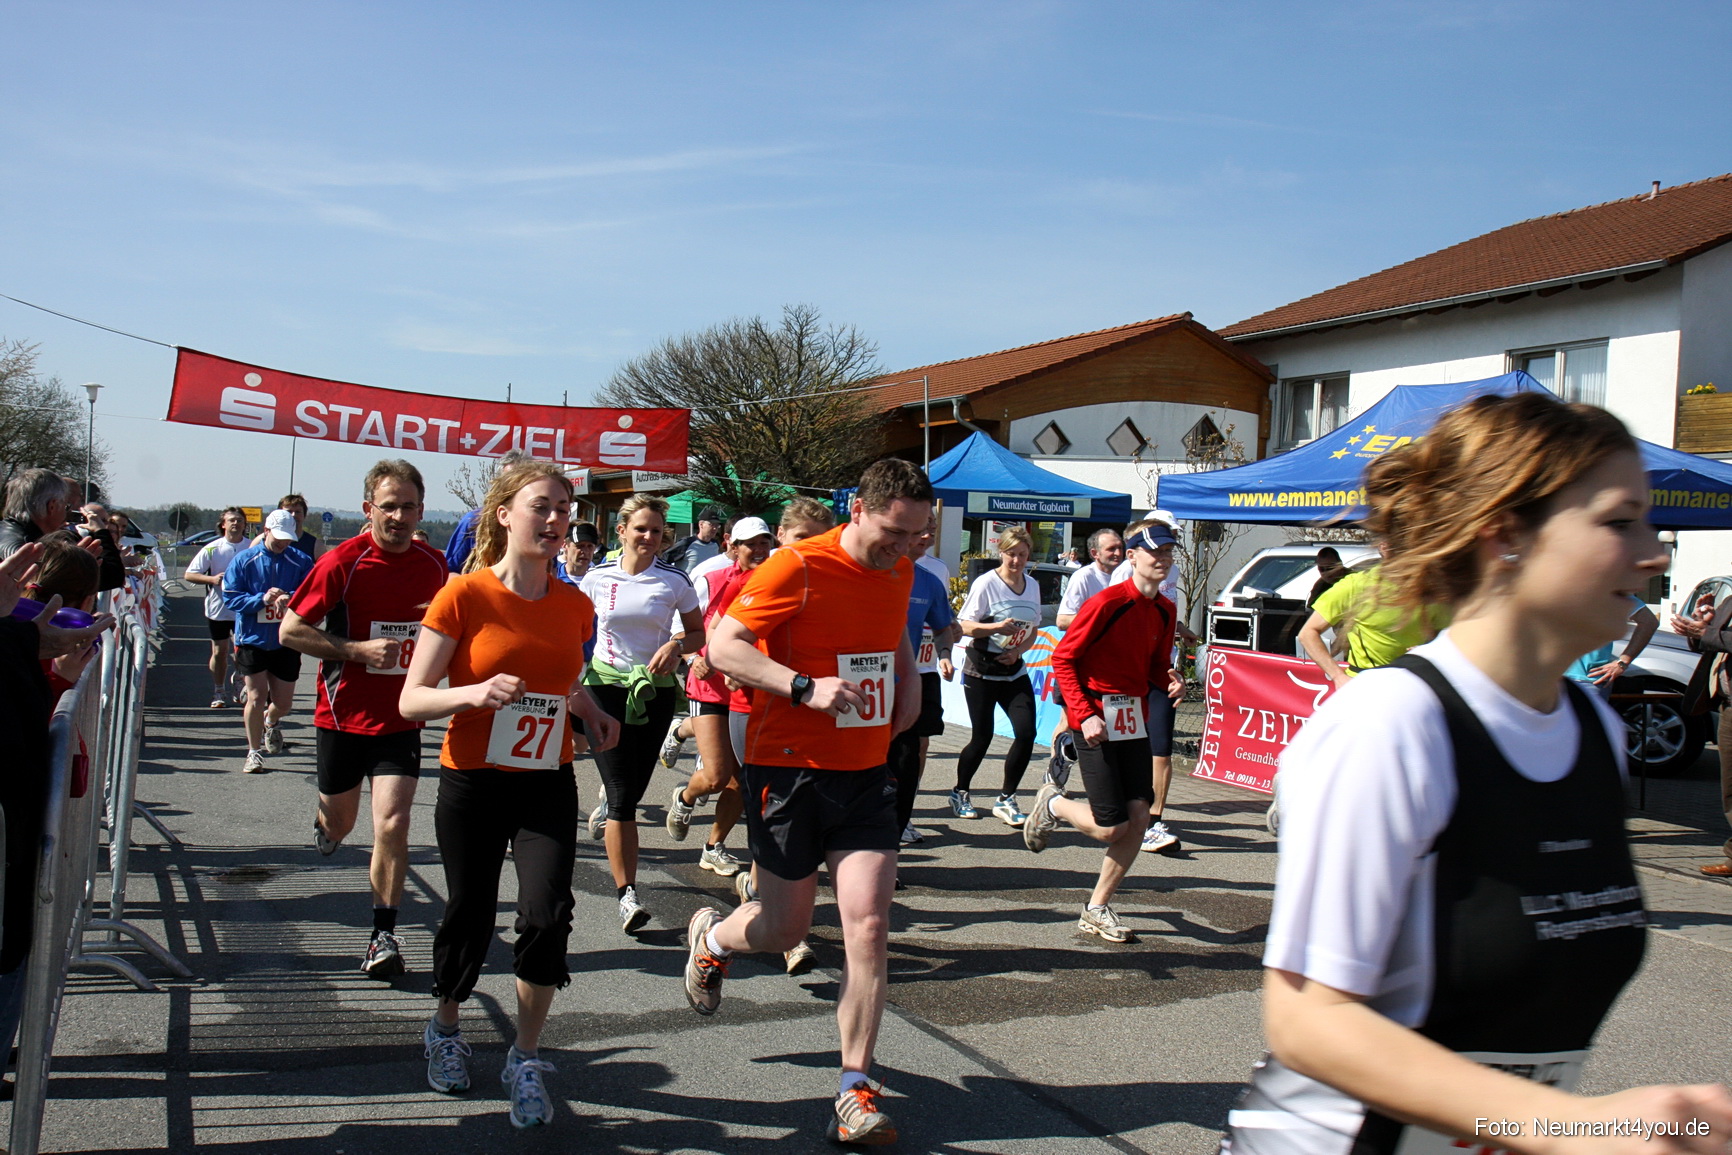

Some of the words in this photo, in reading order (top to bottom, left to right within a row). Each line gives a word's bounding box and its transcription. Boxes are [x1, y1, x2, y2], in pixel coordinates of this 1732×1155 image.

[992, 499, 1037, 511] Neumarkter
[1038, 501, 1070, 513] Tagblatt
[1648, 489, 1732, 509] mmane
[399, 639, 415, 669] 8
[850, 656, 879, 666] MEYER
[919, 643, 933, 663] 18
[850, 665, 879, 673] WERBUNG
[511, 704, 546, 714] WERBUNG
[1199, 652, 1227, 777] ZEITLOS
[1114, 707, 1137, 735] 45
[511, 715, 555, 759] 27
[1236, 773, 1257, 786] 09181
[1261, 779, 1273, 790] 13
